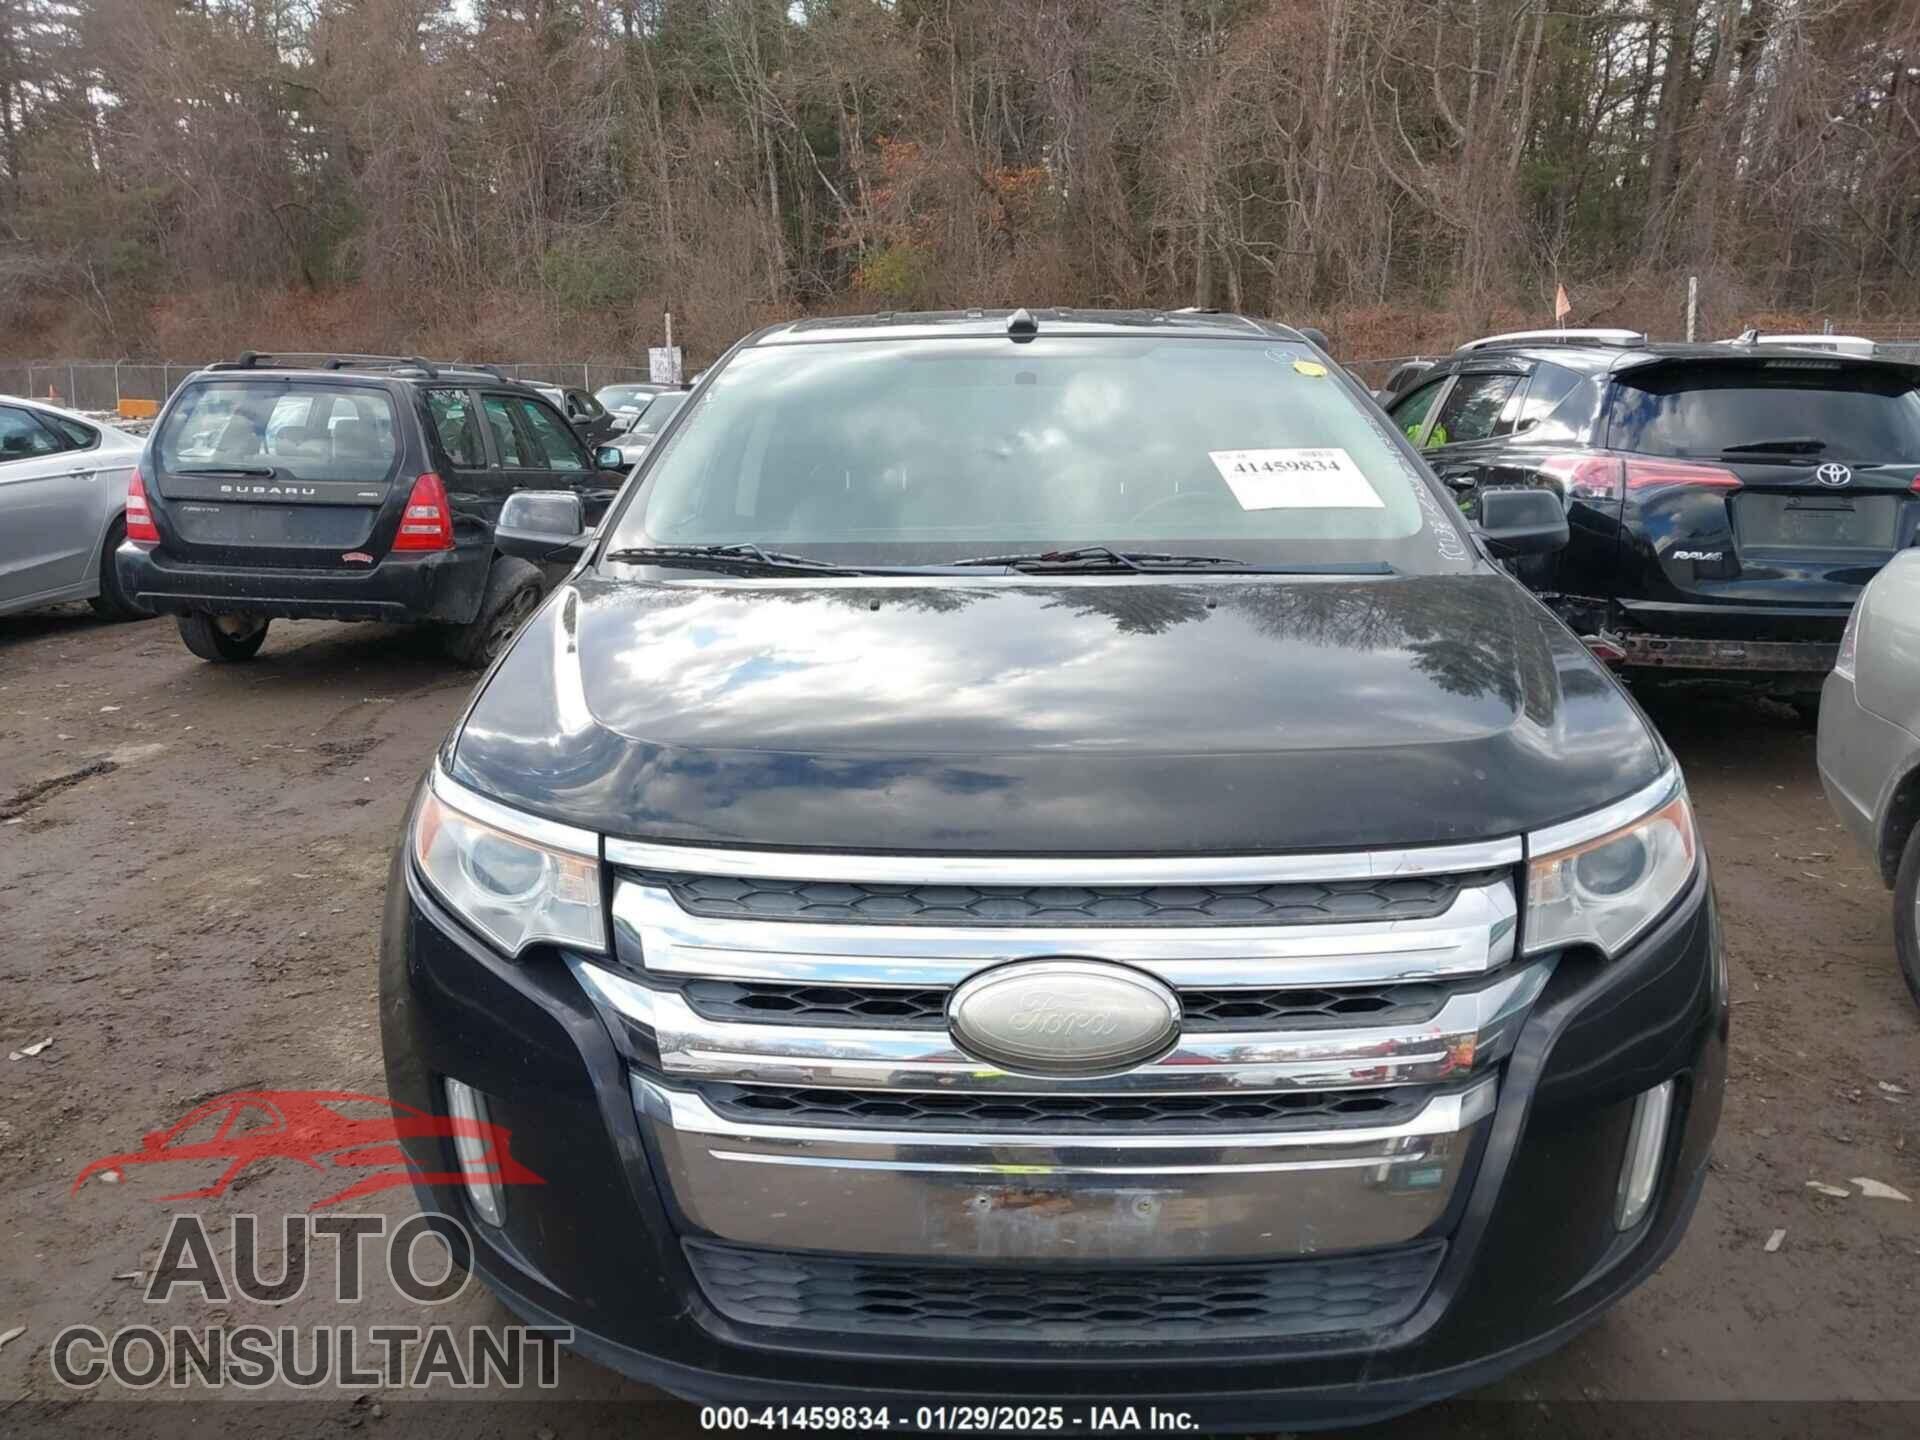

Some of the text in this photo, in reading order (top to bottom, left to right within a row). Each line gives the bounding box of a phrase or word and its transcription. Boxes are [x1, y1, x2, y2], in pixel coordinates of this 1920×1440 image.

[1233, 459, 1341, 474] 41459834
[220, 485, 316, 495] SUBARU
[1008, 991, 1120, 1036] Ford
